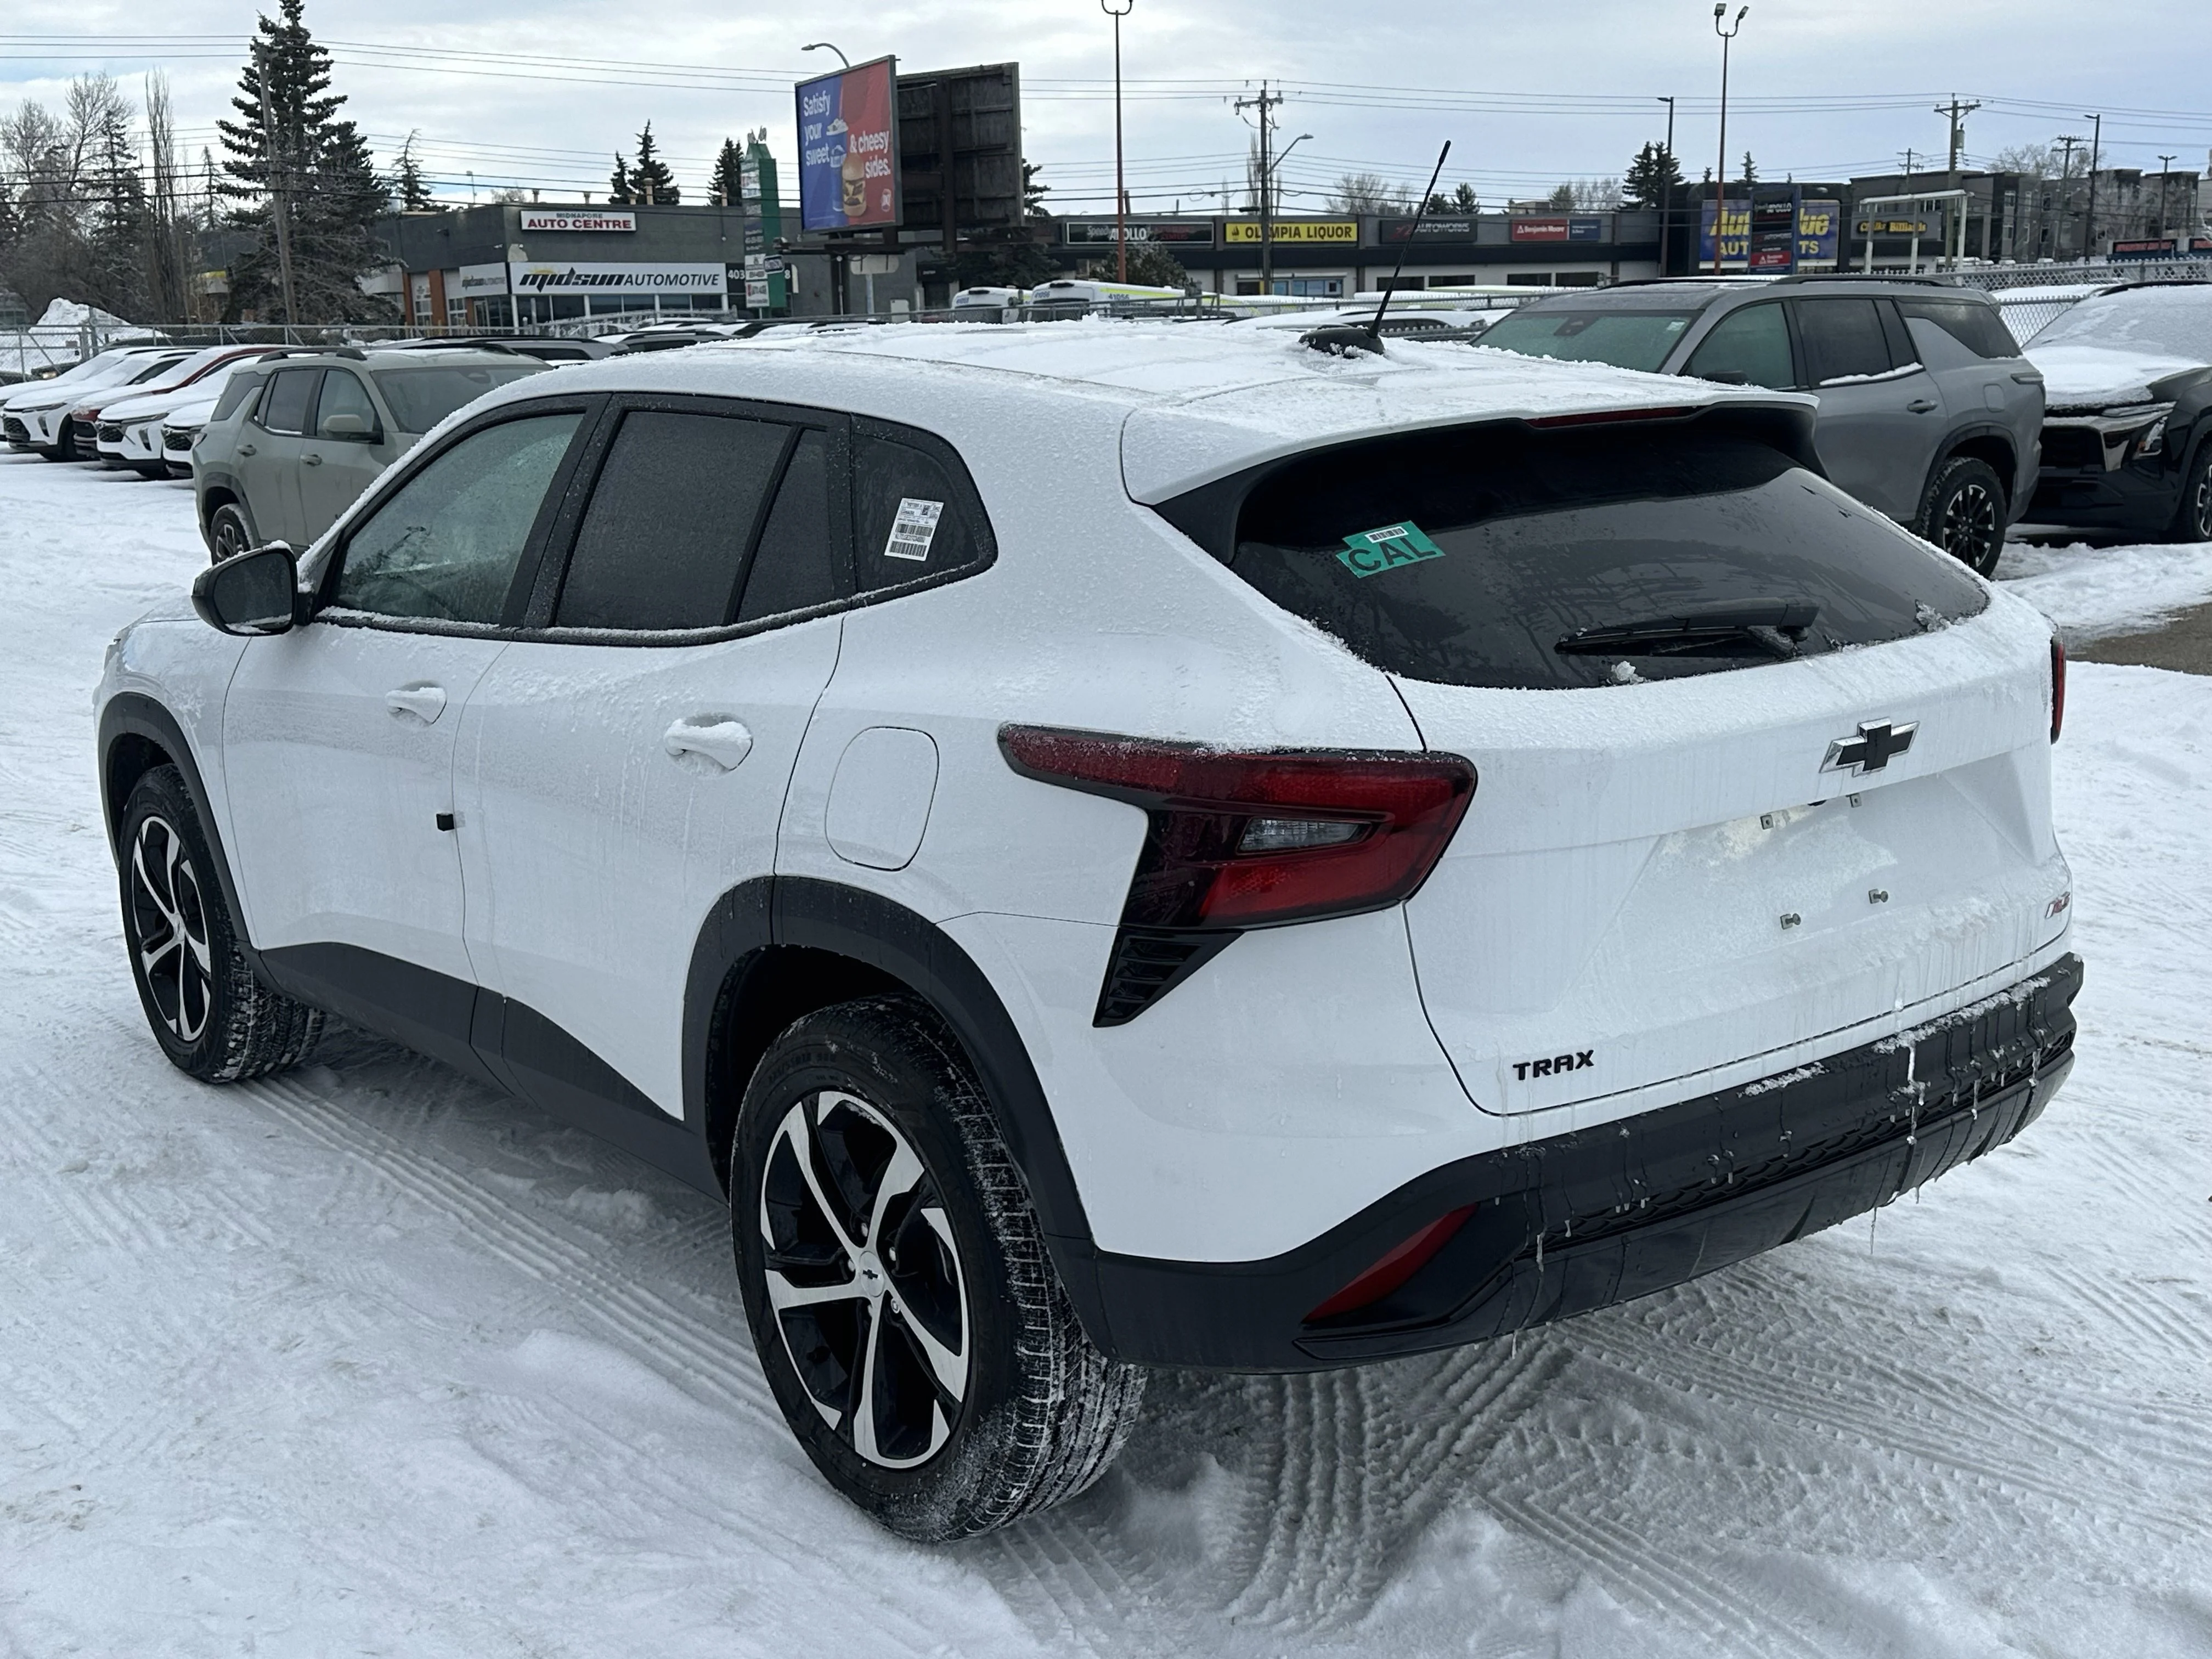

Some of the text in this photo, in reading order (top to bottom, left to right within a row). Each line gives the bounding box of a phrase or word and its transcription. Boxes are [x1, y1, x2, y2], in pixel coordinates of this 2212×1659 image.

[803, 90, 831, 117] Satisfy
[804, 122, 822, 146] your
[850, 131, 889, 154] & cheesy
[805, 143, 830, 166] sweet
[865, 155, 891, 178] sides.
[528, 219, 632, 229] AUTO CENTRE
[1109, 227, 1147, 240] AOLLO
[1245, 226, 1352, 240] OLMPIA LIQUOR
[1348, 538, 1437, 571] CAL
[1513, 1049, 1594, 1080] TRAX
